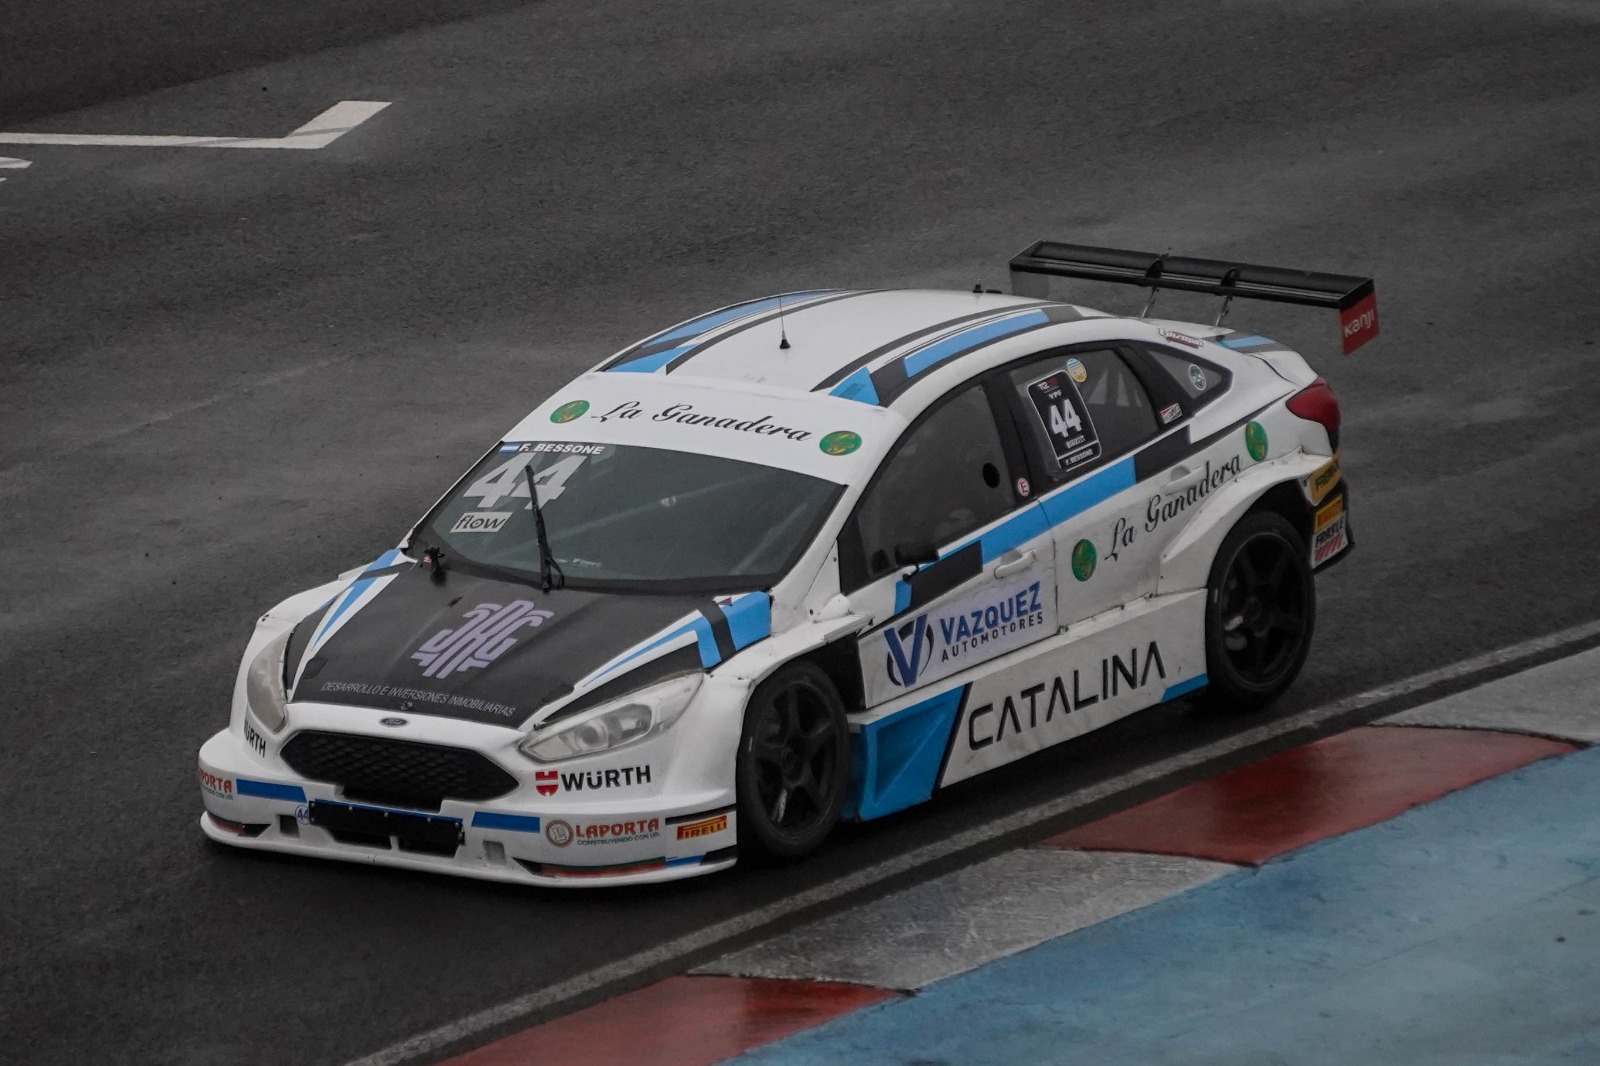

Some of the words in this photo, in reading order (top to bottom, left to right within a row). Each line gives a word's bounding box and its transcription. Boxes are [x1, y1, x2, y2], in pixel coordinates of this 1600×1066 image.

[1343, 308, 1375, 338] kanji
[1048, 389, 1062, 399] YPF
[590, 400, 643, 422] La
[652, 403, 812, 442] Ganadera
[1049, 398, 1082, 438] 44
[518, 443, 530, 452] F.
[533, 443, 605, 455] BESSONE
[462, 452, 588, 510] 44
[454, 514, 507, 530] flow
[1104, 517, 1135, 562] La
[1144, 454, 1242, 533] Ganadera
[940, 580, 1042, 646] VAZQUEZ
[941, 612, 1044, 663] AUTOMOTORES
[320, 682, 381, 695] DESARROLLO
[379, 686, 387, 696] E
[388, 686, 450, 704] INVERSIONES
[449, 695, 516, 718] INMOBILIARIAS
[968, 640, 1167, 751] CATALINA
[561, 765, 652, 792] WÜRTH
[575, 817, 660, 840] LAPORTA
[676, 815, 728, 841] PIRELLI
